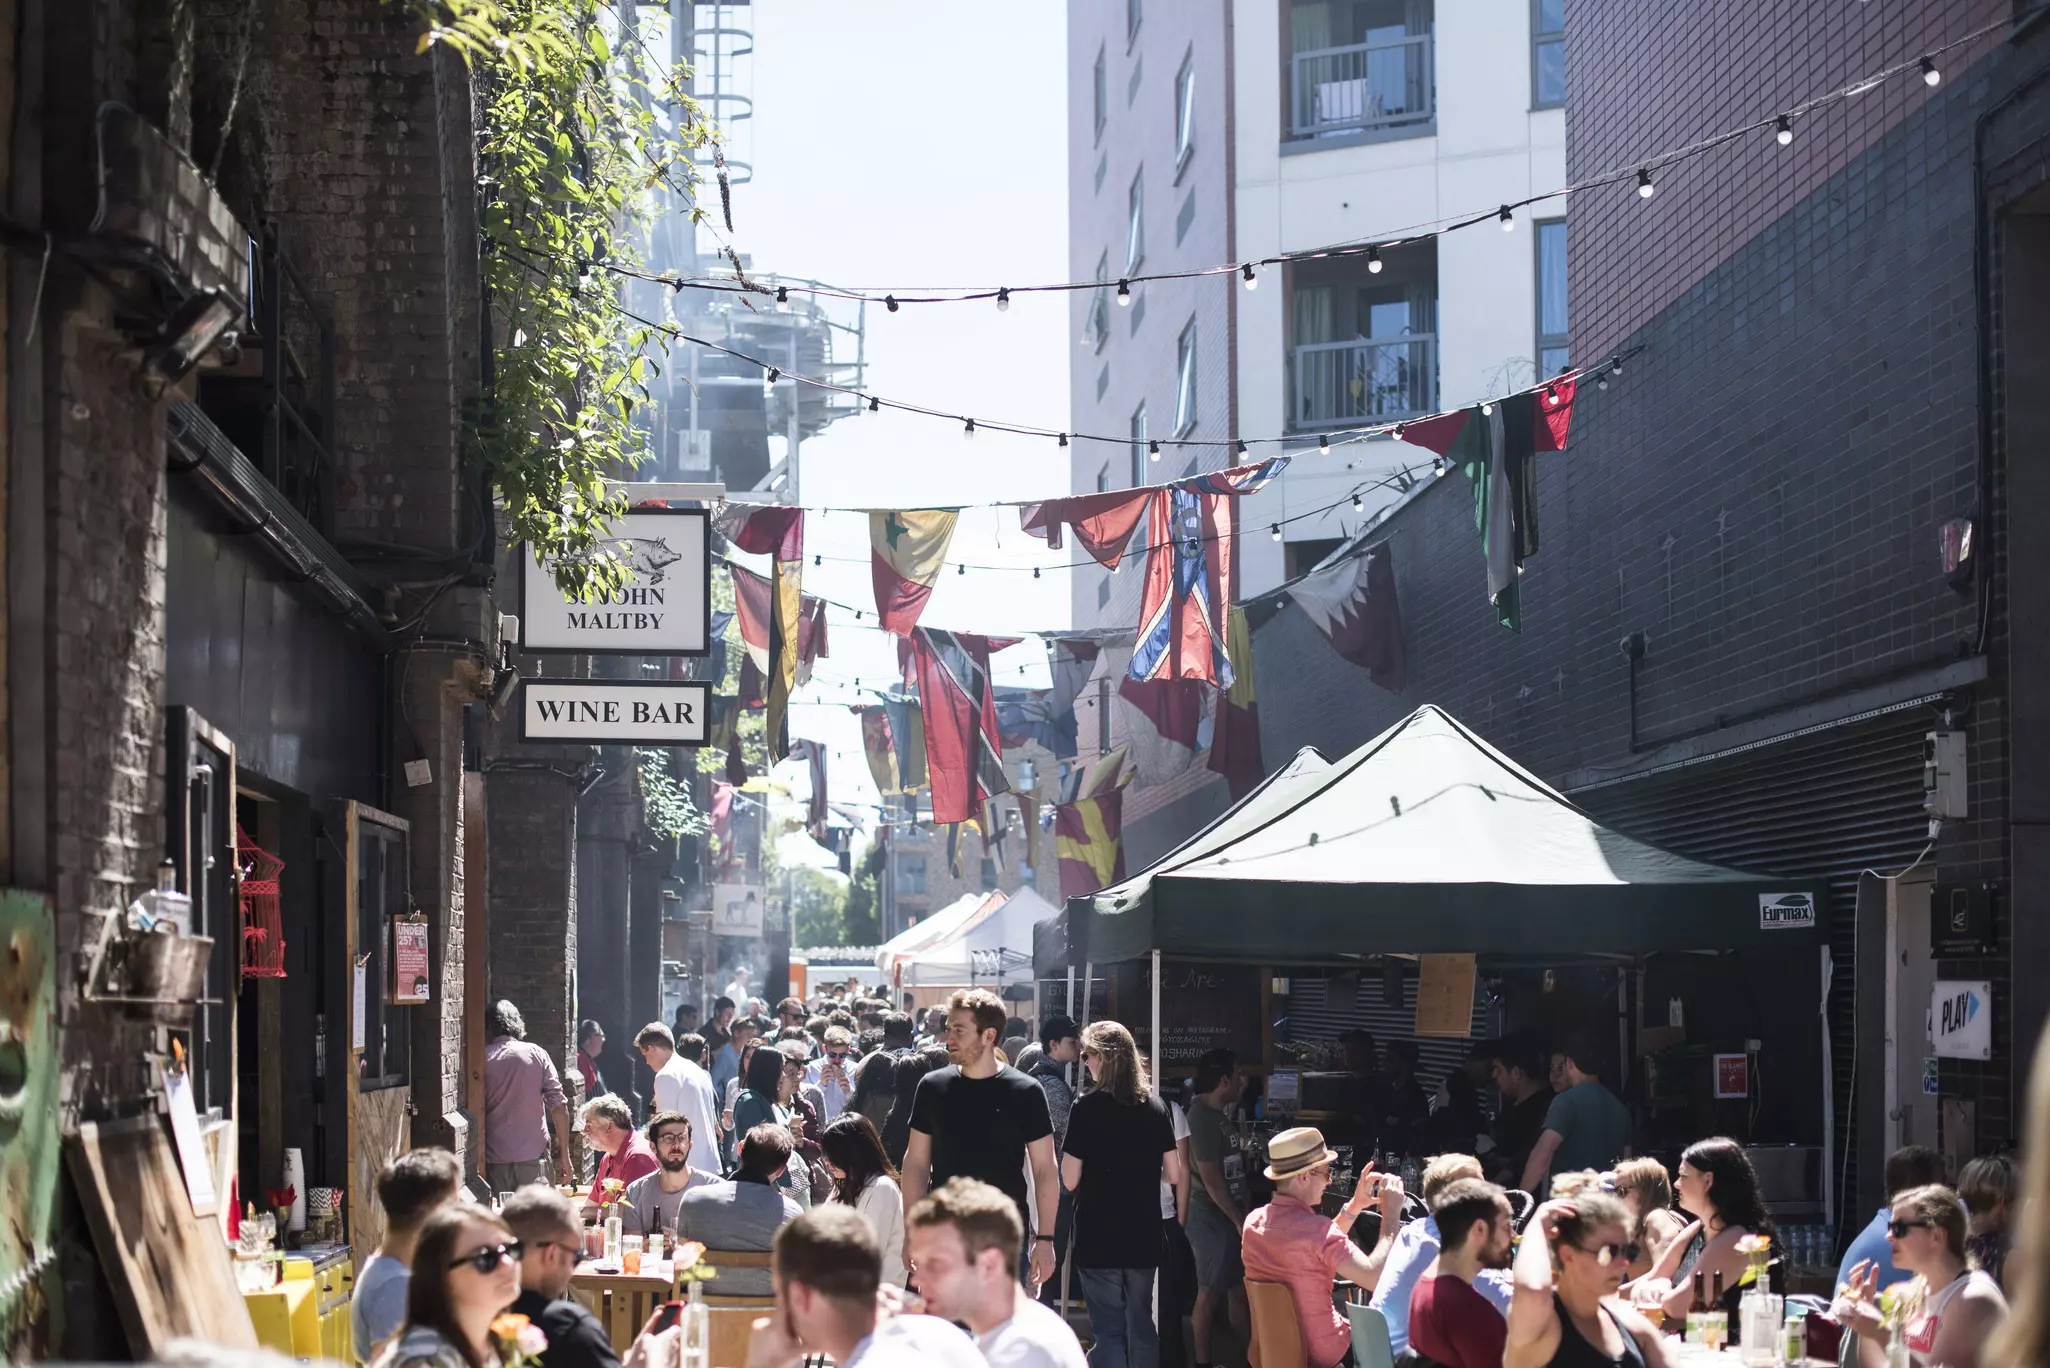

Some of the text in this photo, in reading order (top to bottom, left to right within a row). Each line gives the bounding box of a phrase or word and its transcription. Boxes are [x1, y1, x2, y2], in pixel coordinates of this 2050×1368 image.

[599, 587, 665, 605] JOHN
[567, 612, 664, 630] MALTBY
[536, 700, 695, 724] WINE BAR
[1762, 905, 1810, 921] Eurmax
[398, 925, 425, 936] UNDER
[398, 935, 412, 946] 25?
[1941, 991, 1969, 1036] PLAY
